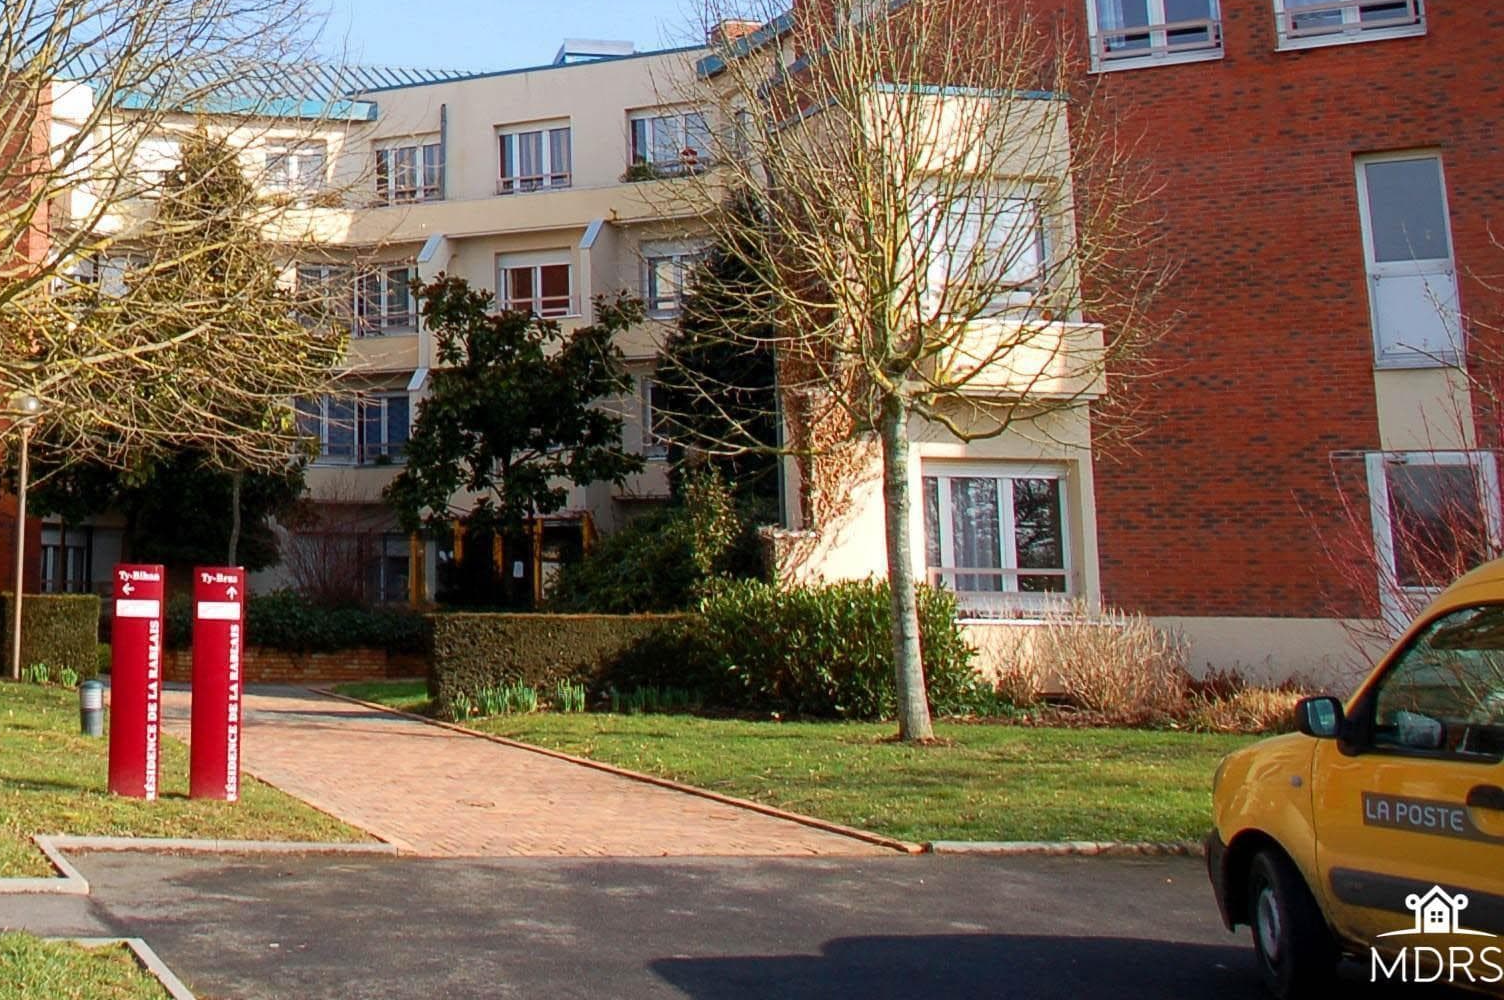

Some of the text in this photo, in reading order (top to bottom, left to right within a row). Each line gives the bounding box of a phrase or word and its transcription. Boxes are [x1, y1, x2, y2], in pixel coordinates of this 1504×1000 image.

[148, 682, 158, 699] LA
[228, 683, 238, 701] LA
[147, 702, 157, 720] DE
[227, 704, 238, 722] DE
[144, 724, 156, 800] RÉSIDENCE
[225, 725, 238, 801] RÉSIDENCE
[1366, 798, 1464, 831] LA POSTE
